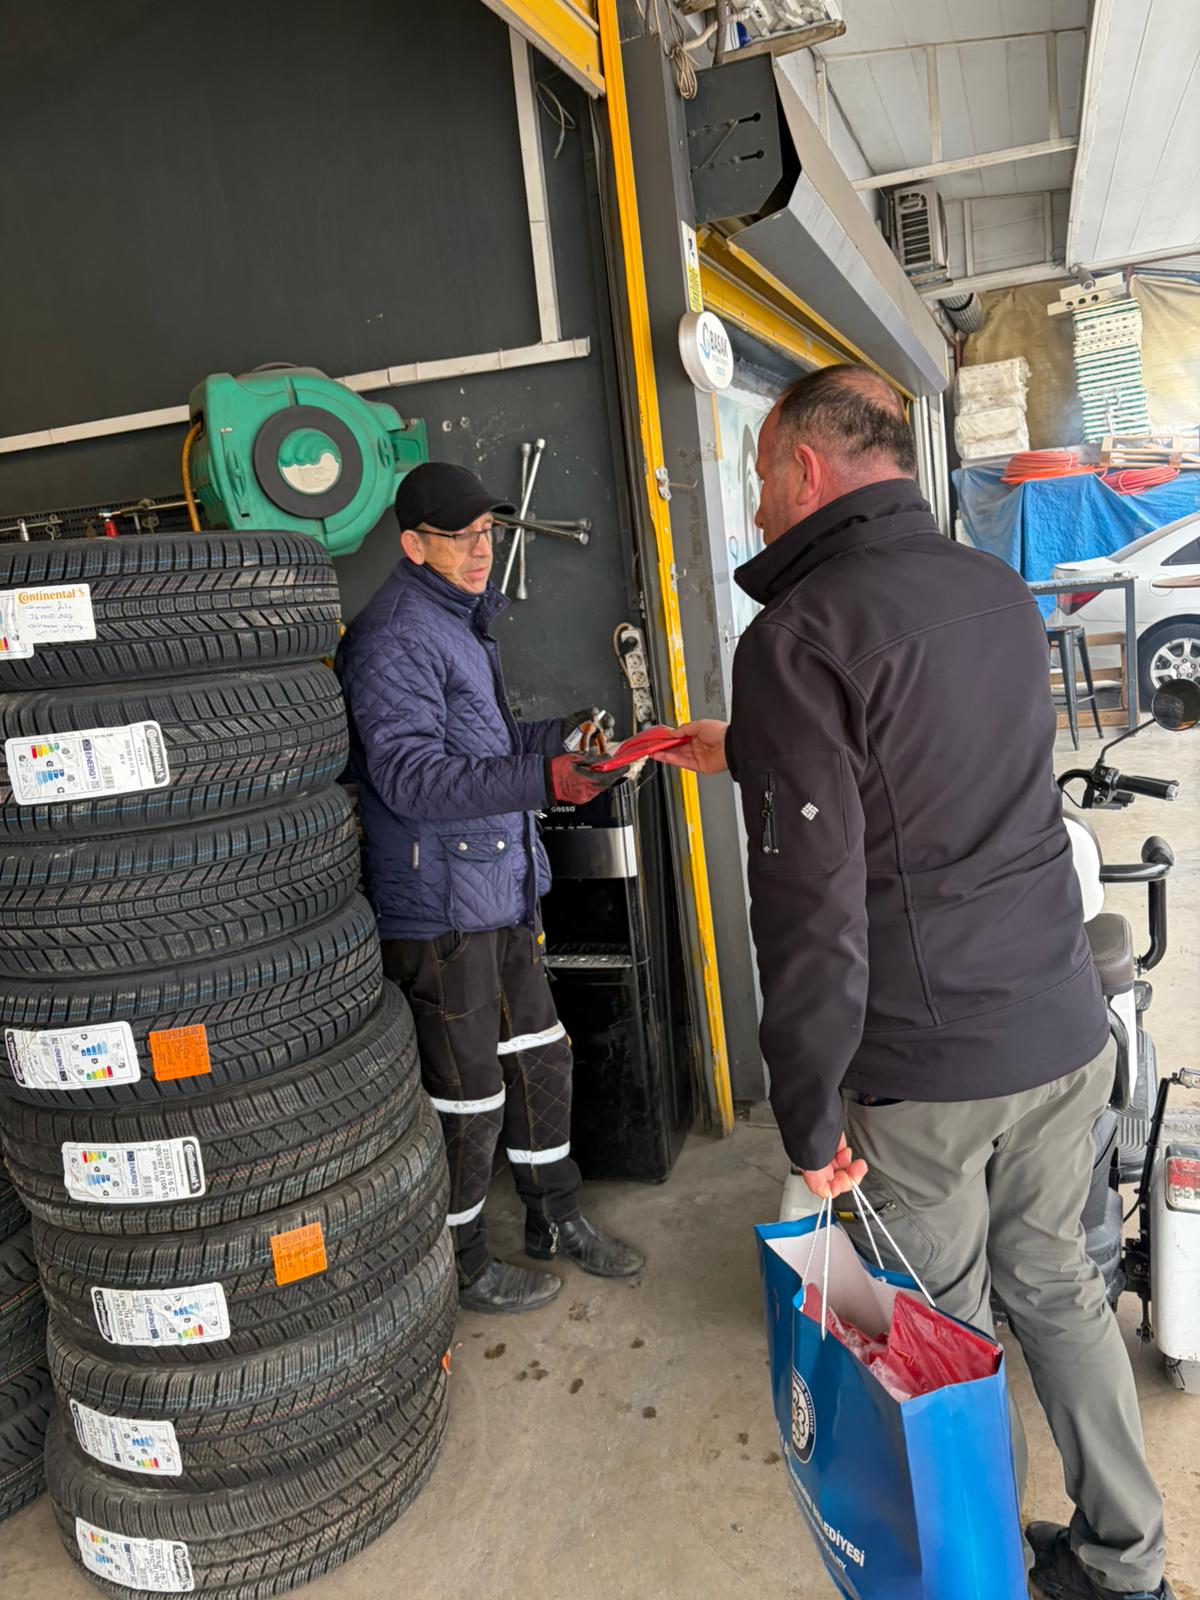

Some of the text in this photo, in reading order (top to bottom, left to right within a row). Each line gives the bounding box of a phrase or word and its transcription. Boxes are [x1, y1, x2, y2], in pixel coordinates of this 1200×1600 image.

[18, 589, 76, 604] Continental
[146, 728, 163, 771] Continental
[184, 1144, 199, 1183] Continental
